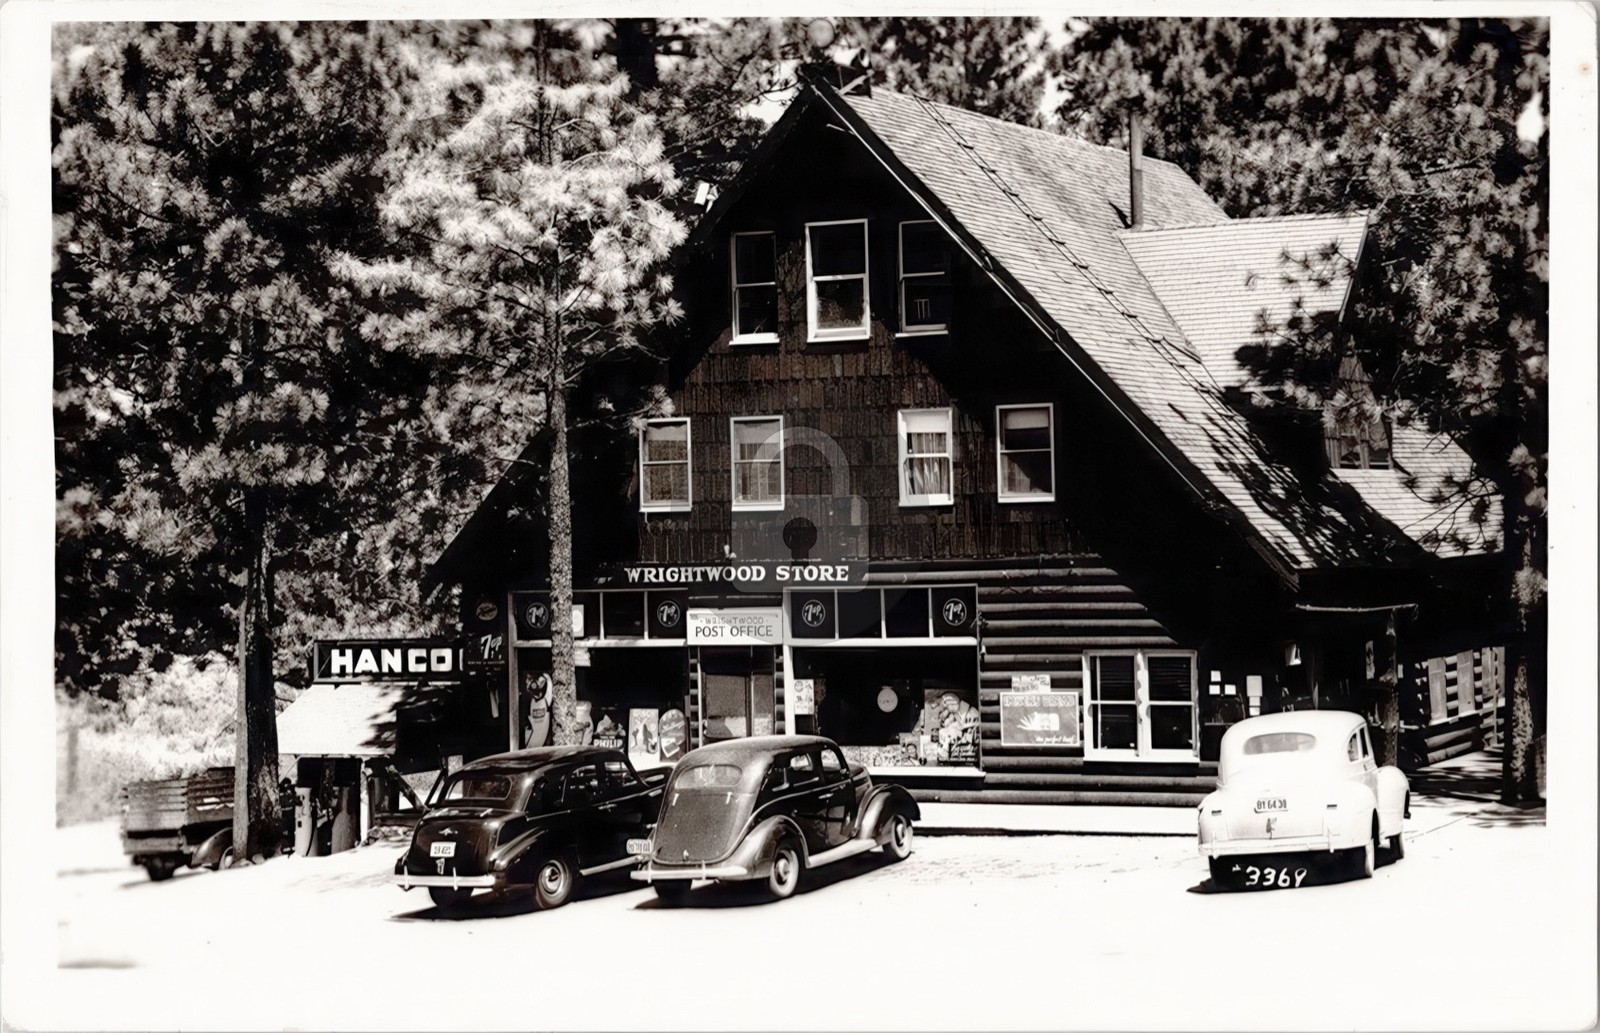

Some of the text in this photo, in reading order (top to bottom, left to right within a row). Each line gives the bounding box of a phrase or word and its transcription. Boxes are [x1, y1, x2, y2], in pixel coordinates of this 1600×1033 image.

[624, 563, 849, 583] WRIGHTWOOD STORE
[695, 625, 773, 637] POST OFFICE
[330, 647, 464, 674] HANCO
